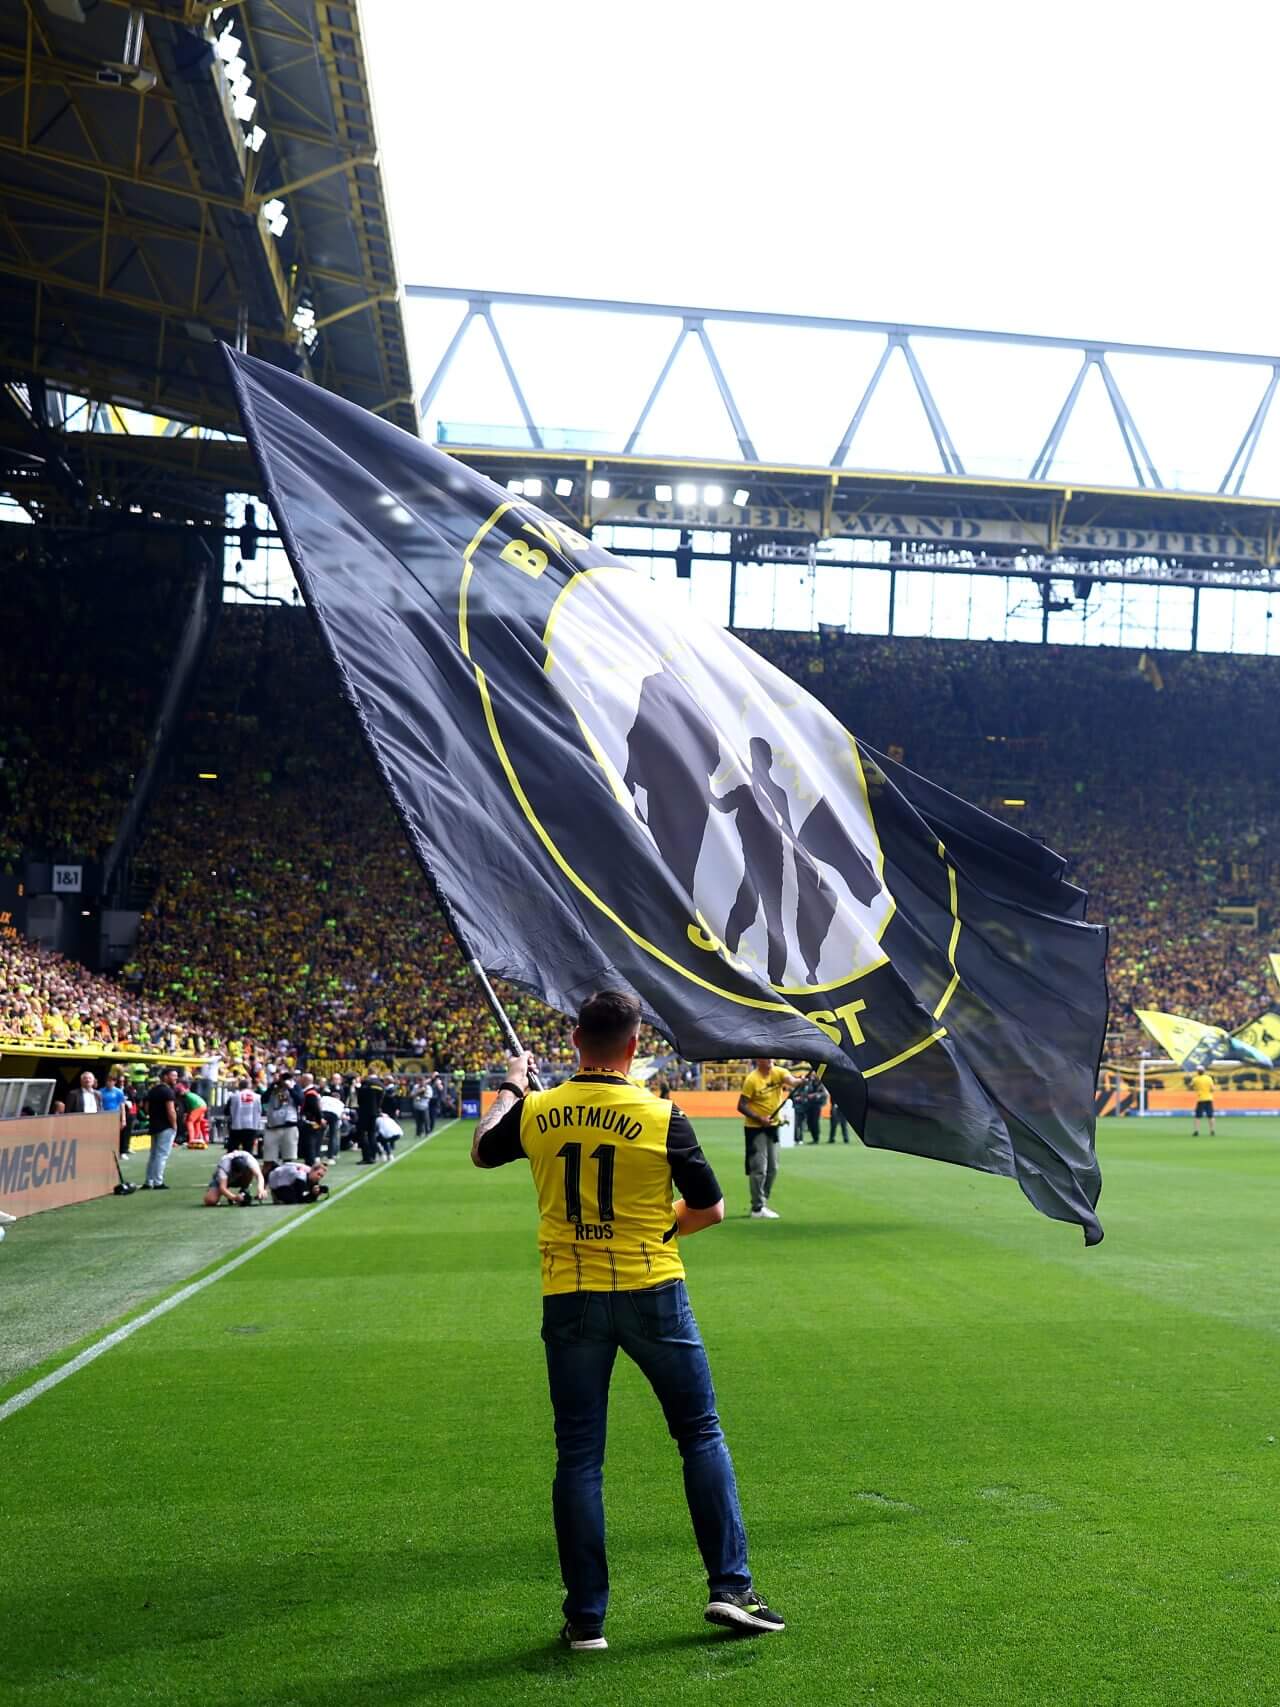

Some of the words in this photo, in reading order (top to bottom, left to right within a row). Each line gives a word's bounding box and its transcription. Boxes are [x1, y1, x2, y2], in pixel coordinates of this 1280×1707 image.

[636, 501, 805, 529] GELBE
[837, 513, 983, 539] WAND
[55, 871, 80, 886] 1&1
[536, 1105, 644, 1141] DORTMUND
[556, 1141, 617, 1224] 11
[575, 1223, 614, 1241] REUS
